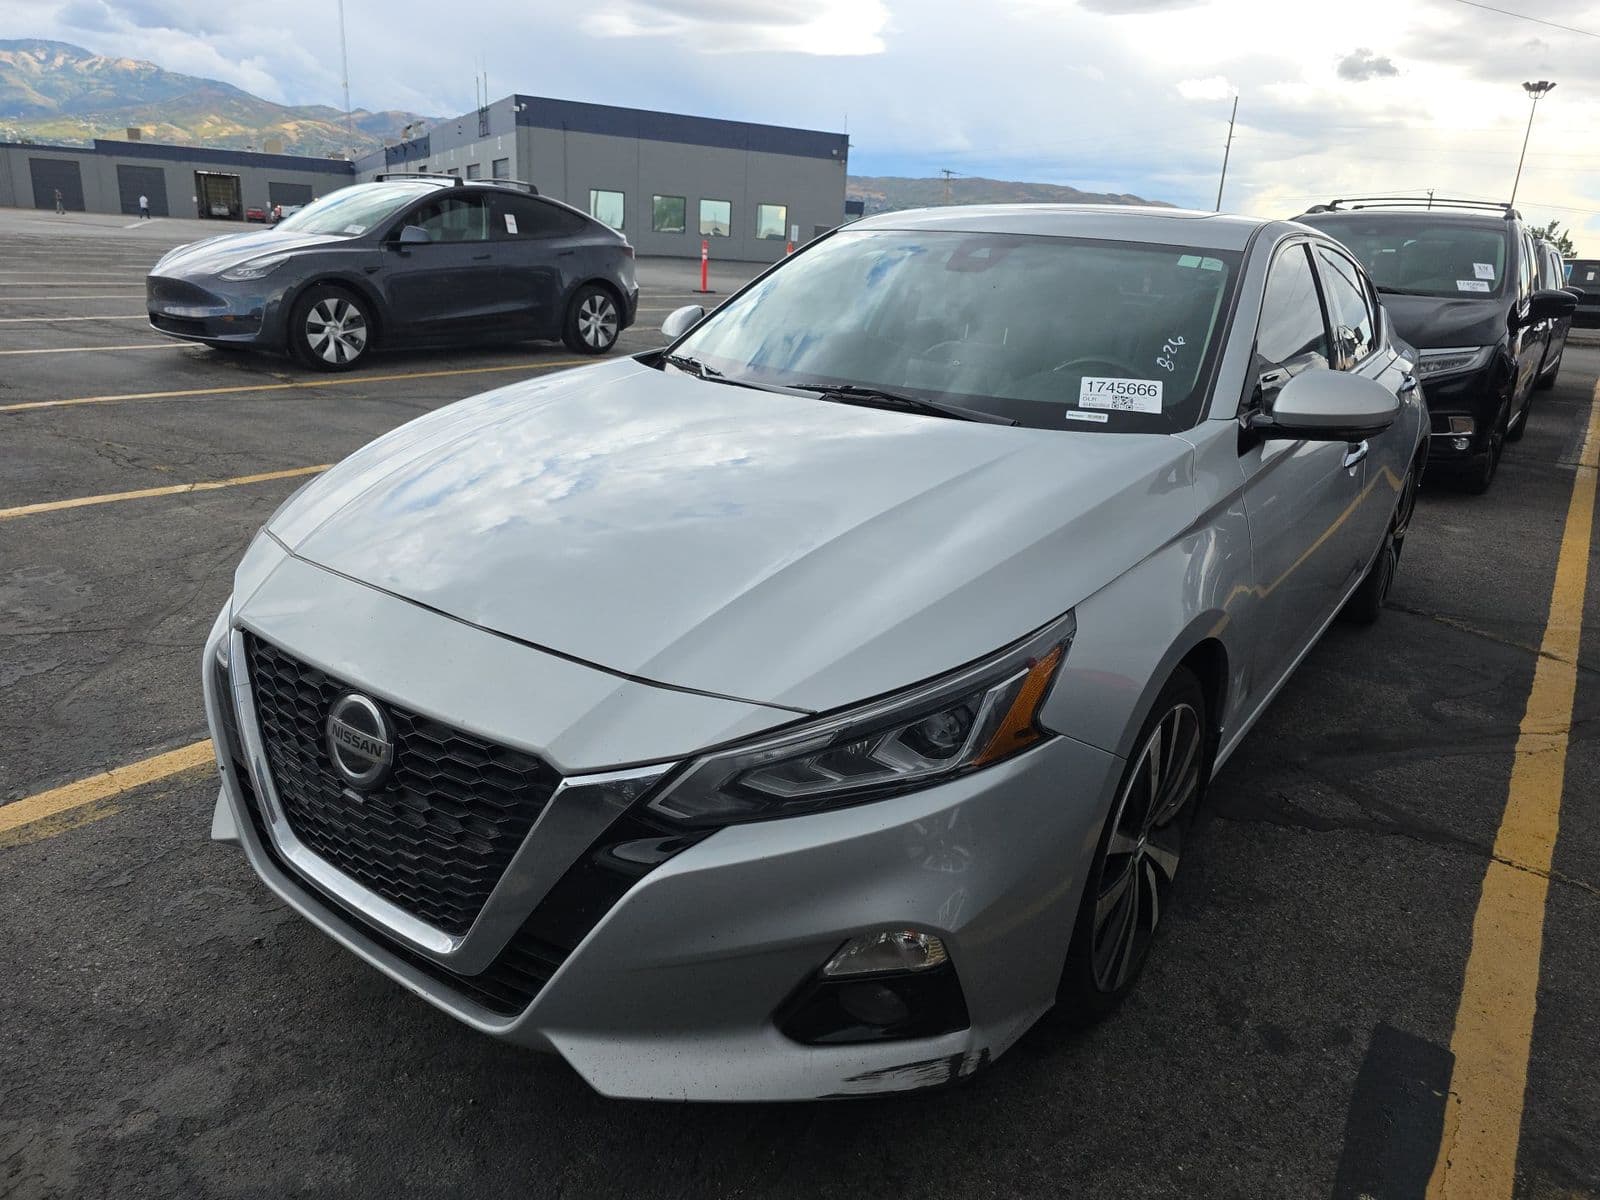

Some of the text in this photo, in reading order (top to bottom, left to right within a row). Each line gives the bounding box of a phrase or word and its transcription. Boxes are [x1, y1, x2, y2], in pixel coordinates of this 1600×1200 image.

[1156, 335, 1186, 372] 8-26
[1087, 380, 1158, 397] 1745666
[332, 723, 383, 757] NISSAN
